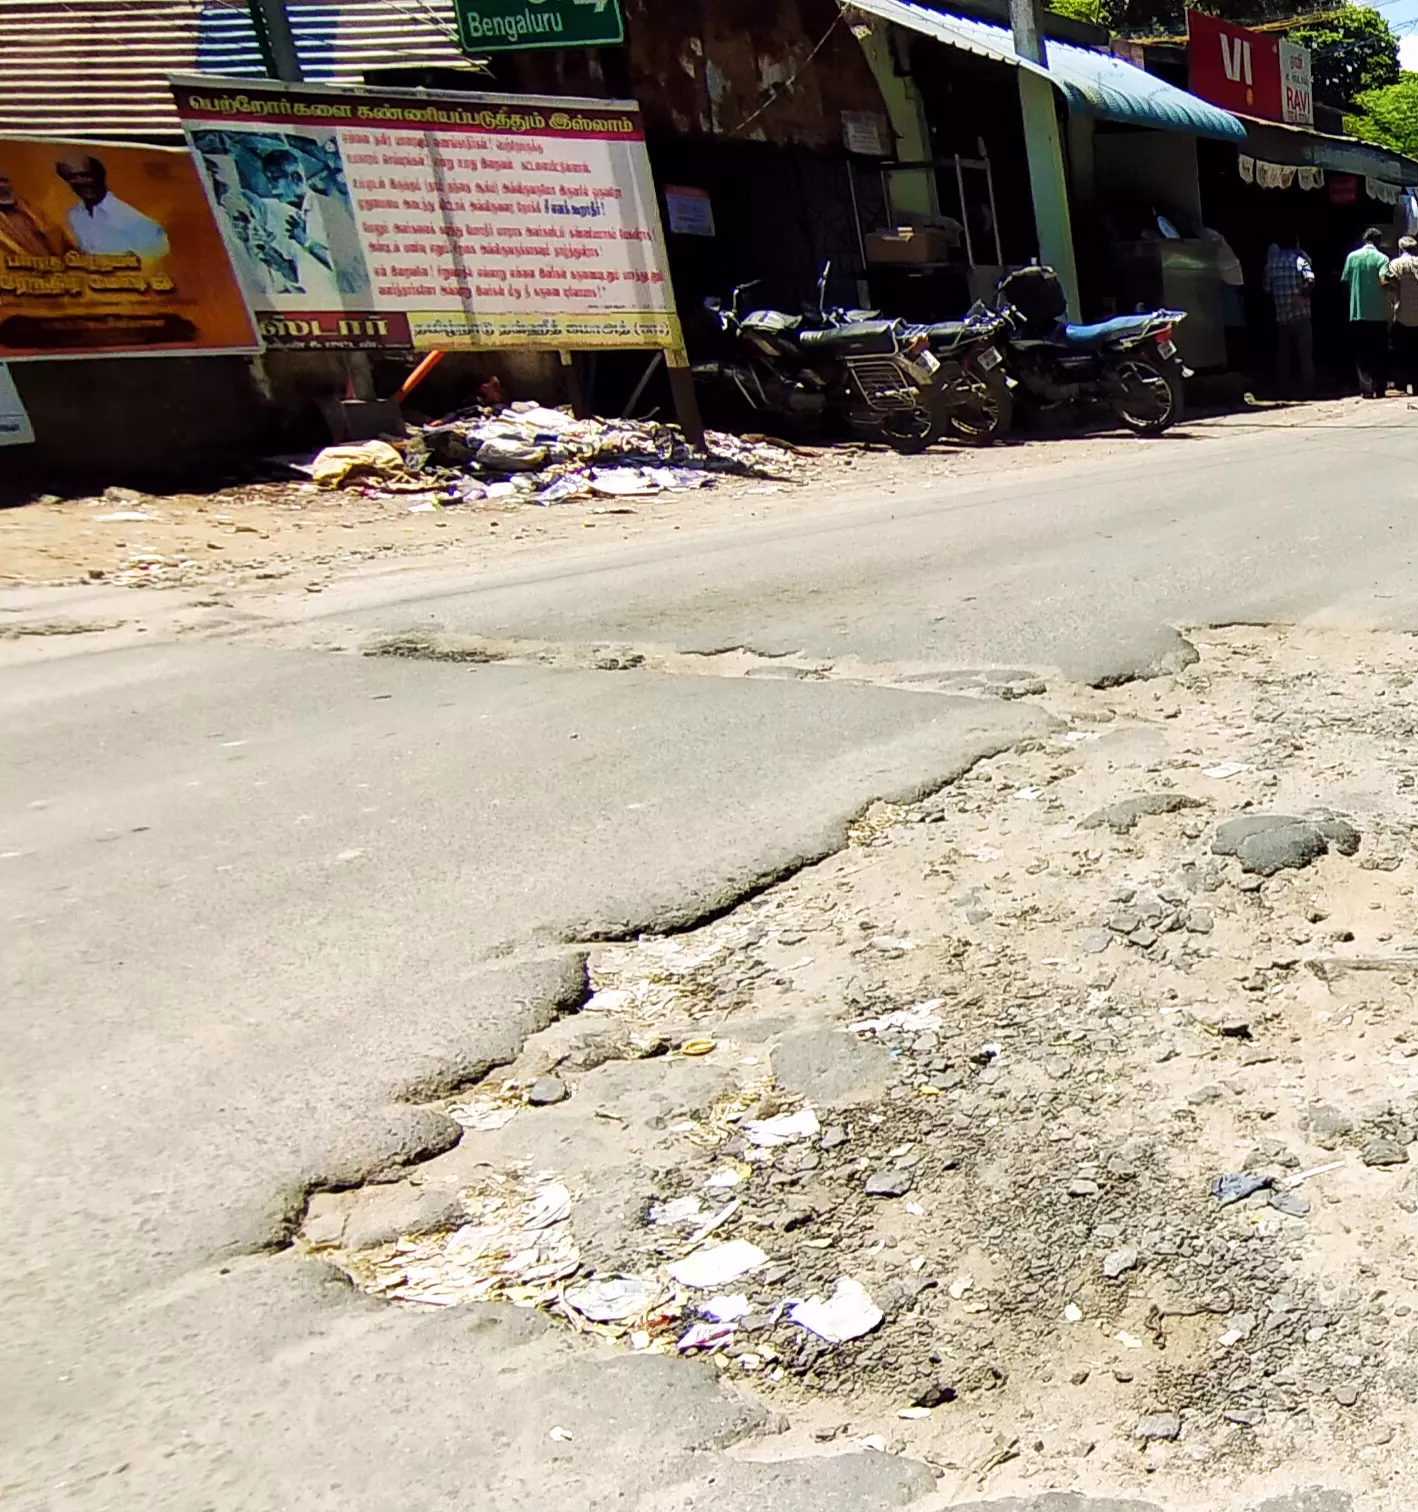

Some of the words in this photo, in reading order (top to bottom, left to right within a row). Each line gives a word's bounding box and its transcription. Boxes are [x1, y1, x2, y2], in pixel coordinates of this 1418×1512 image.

[467, 8, 564, 42] Bengaluru
[189, 95, 352, 118] பெற்றோர்களை
[356, 103, 546, 132] கண்ணியப்படுத்தும்
[549, 112, 634, 133] இஸ்லாம்
[1286, 85, 1310, 114] RAVI
